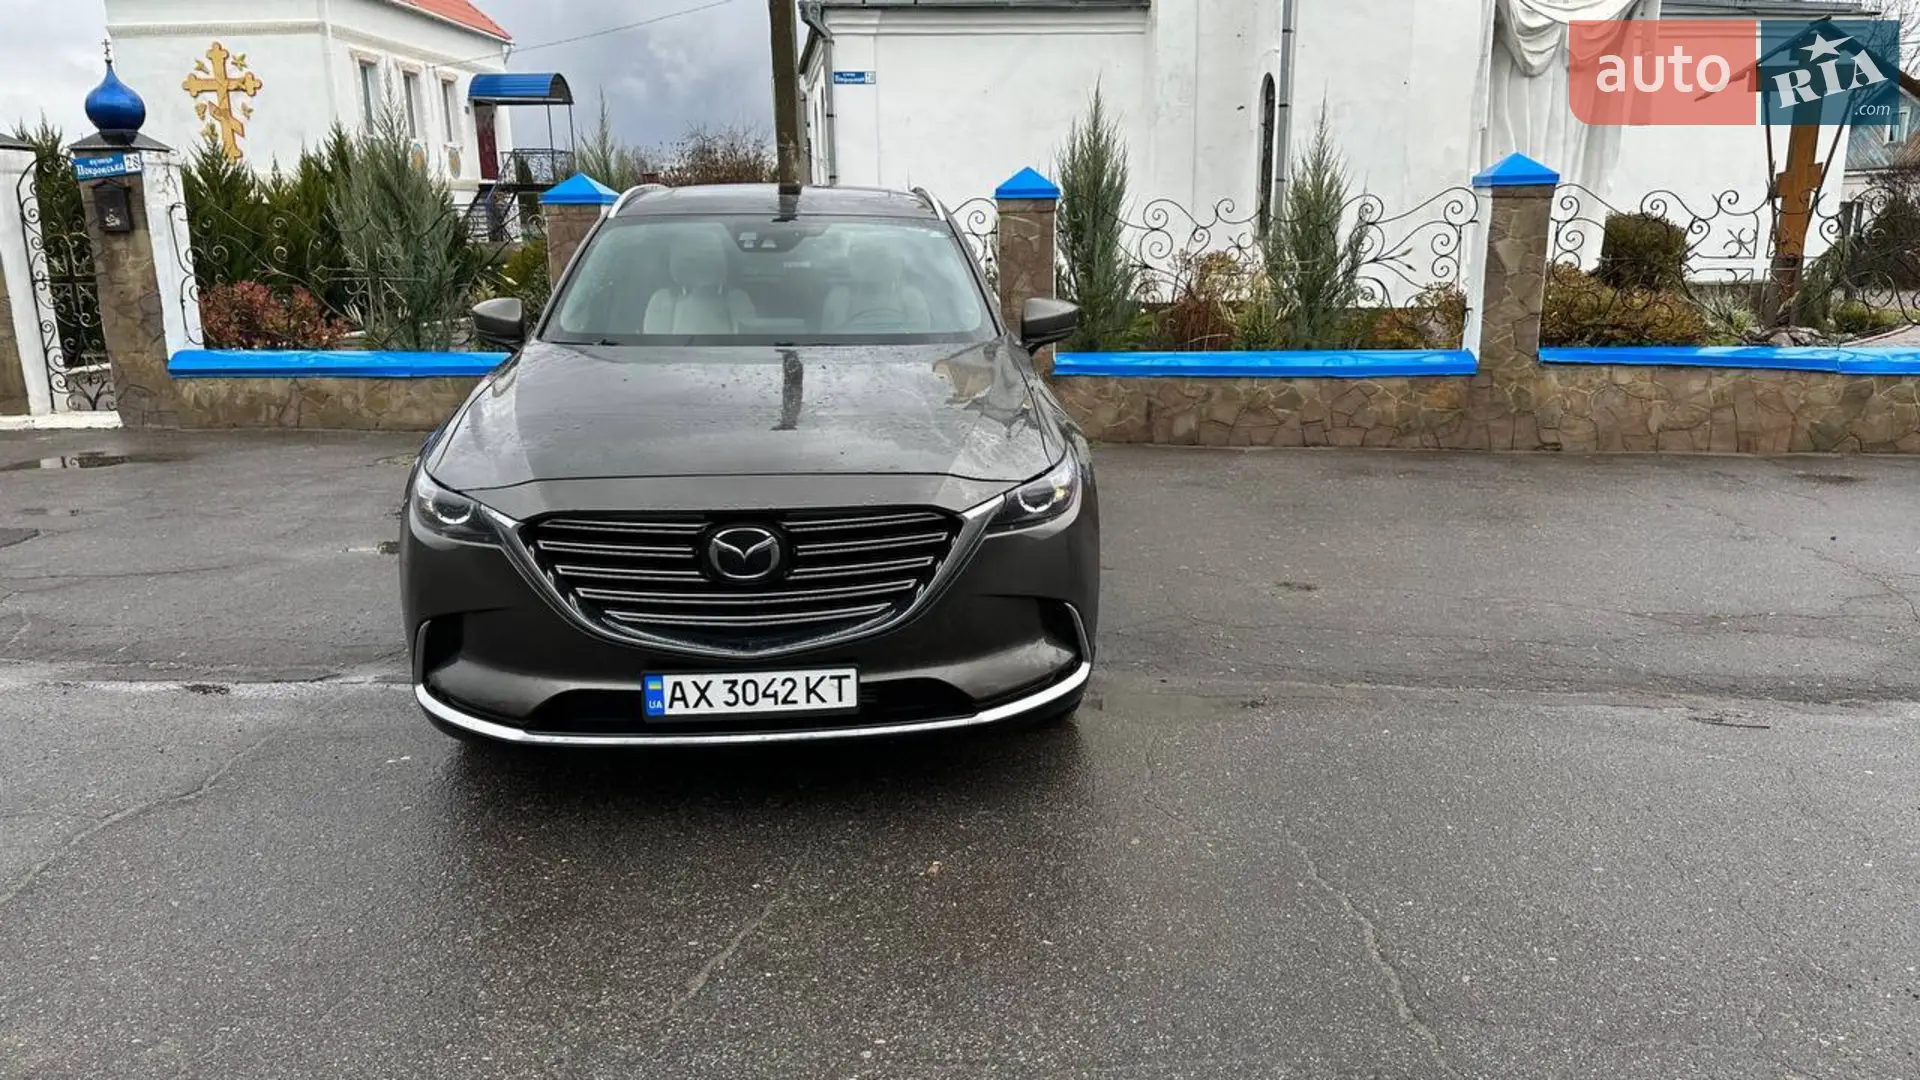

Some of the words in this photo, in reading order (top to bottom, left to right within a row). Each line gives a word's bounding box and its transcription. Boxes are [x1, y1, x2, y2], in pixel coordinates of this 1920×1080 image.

[668, 680, 714, 708] AX
[722, 677, 798, 706] 3042
[805, 675, 851, 704] KT
[649, 701, 663, 709] UA
